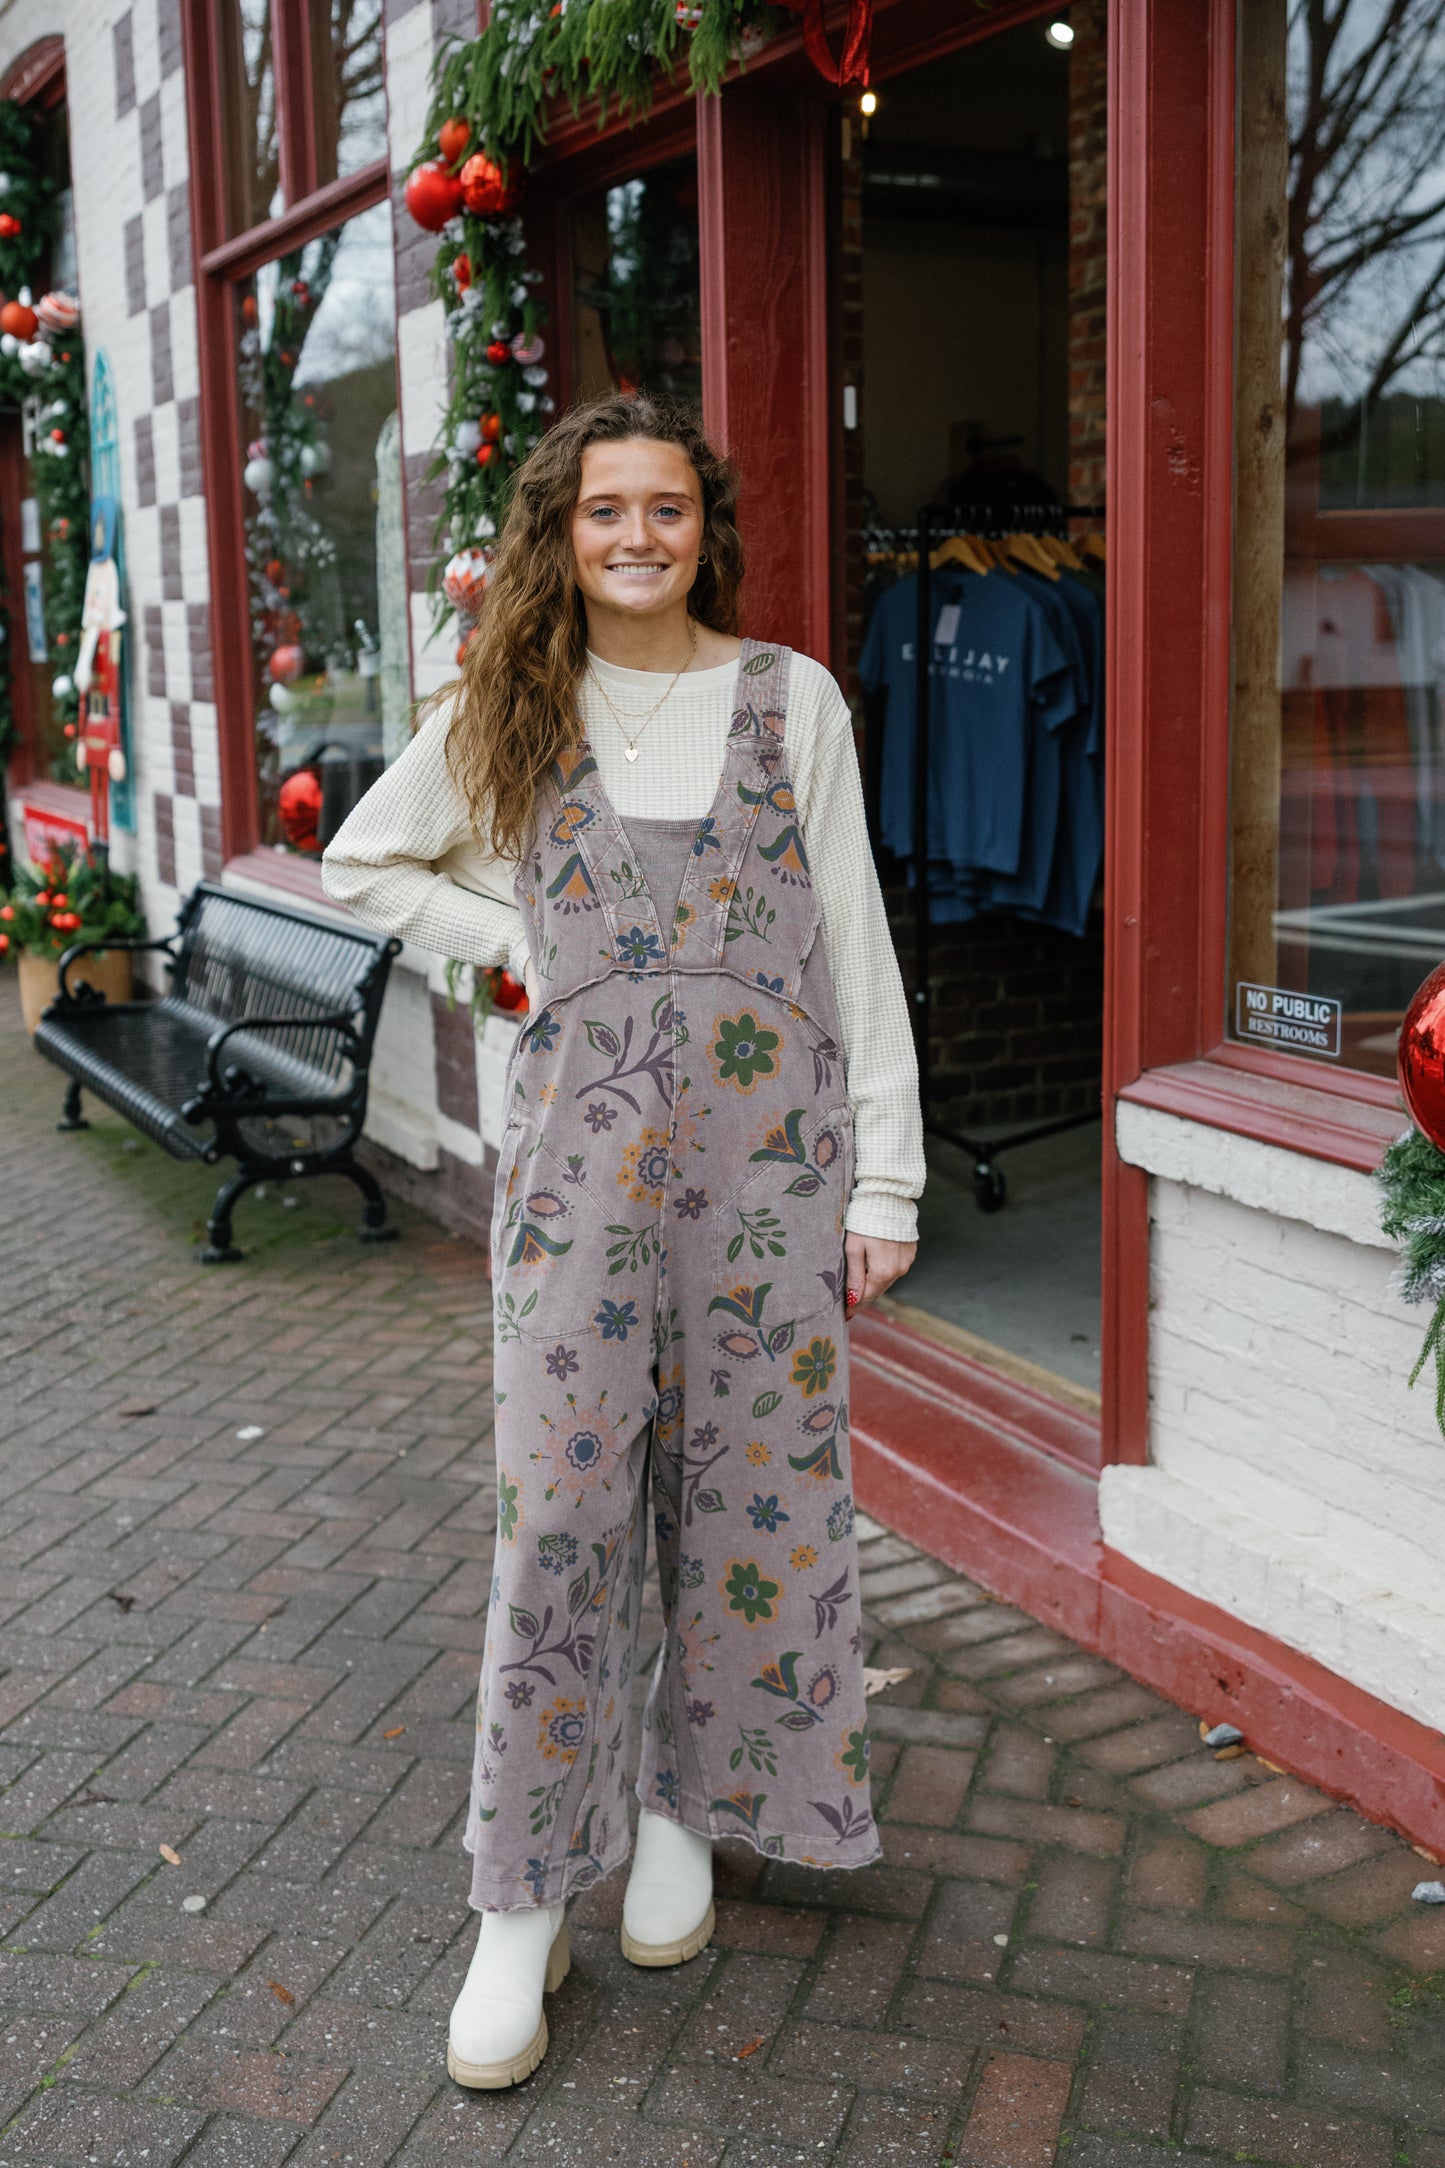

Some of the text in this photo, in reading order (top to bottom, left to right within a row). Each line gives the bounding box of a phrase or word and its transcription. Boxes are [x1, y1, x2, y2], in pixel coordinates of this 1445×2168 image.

[902, 643, 1009, 674] ELIJAY
[1246, 990, 1331, 1024] NO PUBLIC
[1248, 1017, 1329, 1047] RESTROOMS
